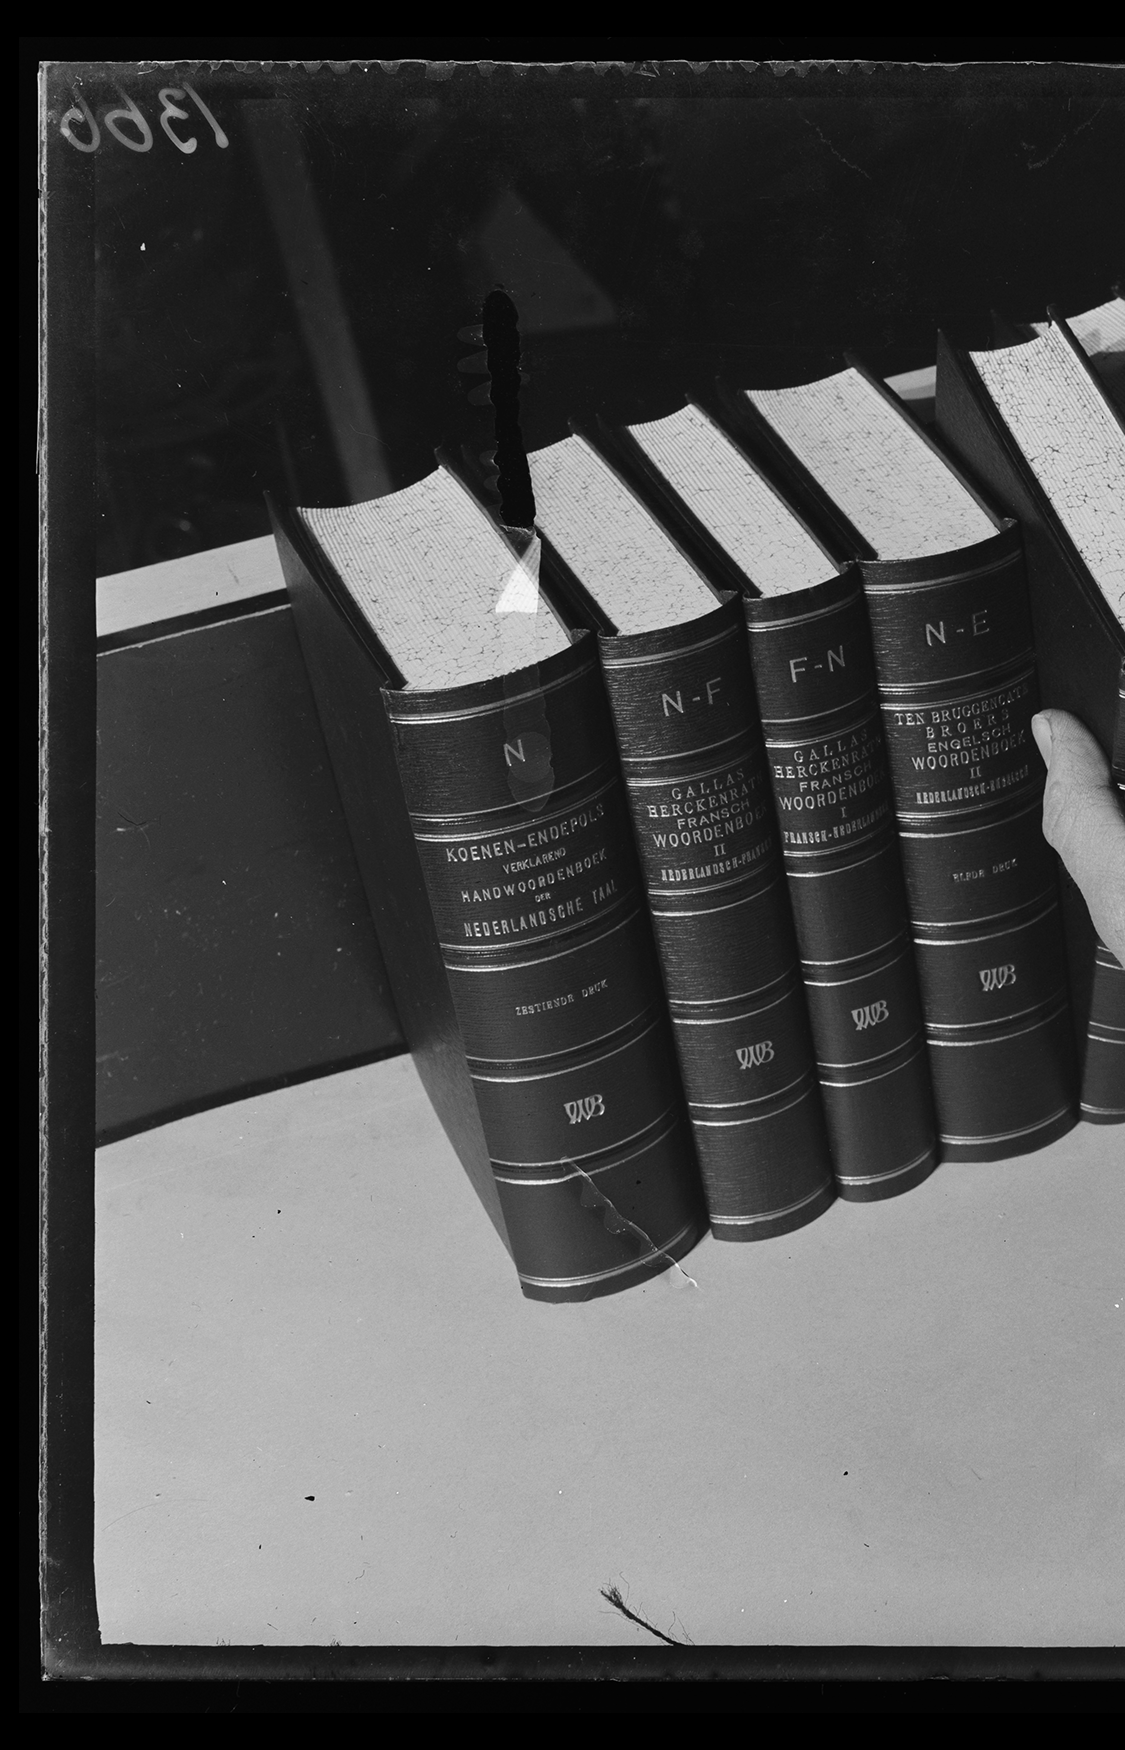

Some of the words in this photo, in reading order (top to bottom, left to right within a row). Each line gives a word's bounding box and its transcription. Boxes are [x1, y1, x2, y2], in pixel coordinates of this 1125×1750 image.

[925, 609, 990, 647] N-E
[789, 645, 845, 683] F-N
[893, 711, 926, 726] TEN
[925, 707, 1010, 739] BROERS
[503, 739, 526, 767] N
[793, 728, 868, 763] GALLAS
[910, 728, 1026, 770] WOORDENBOEK
[927, 722, 1011, 753] ENGELSCH
[671, 769, 745, 800] GALLAS
[778, 763, 885, 811] WOORDENBOEK
[799, 759, 871, 793] FRANSCH
[968, 765, 982, 779] II
[652, 799, 767, 848] WOORDENBOEK
[676, 798, 750, 830] FRANSCH
[840, 806, 848, 819] I
[446, 803, 605, 863] KOENEN-ENDEPOLS
[502, 847, 567, 874] VERKLAREND
[713, 843, 727, 857] II
[461, 847, 607, 903] HANDWOORDENBOEK
[464, 897, 583, 937] NEDERLANDSCHE
[592, 879, 618, 905] TAAL
[535, 892, 551, 903] DER
[581, 978, 609, 998] DRUK
